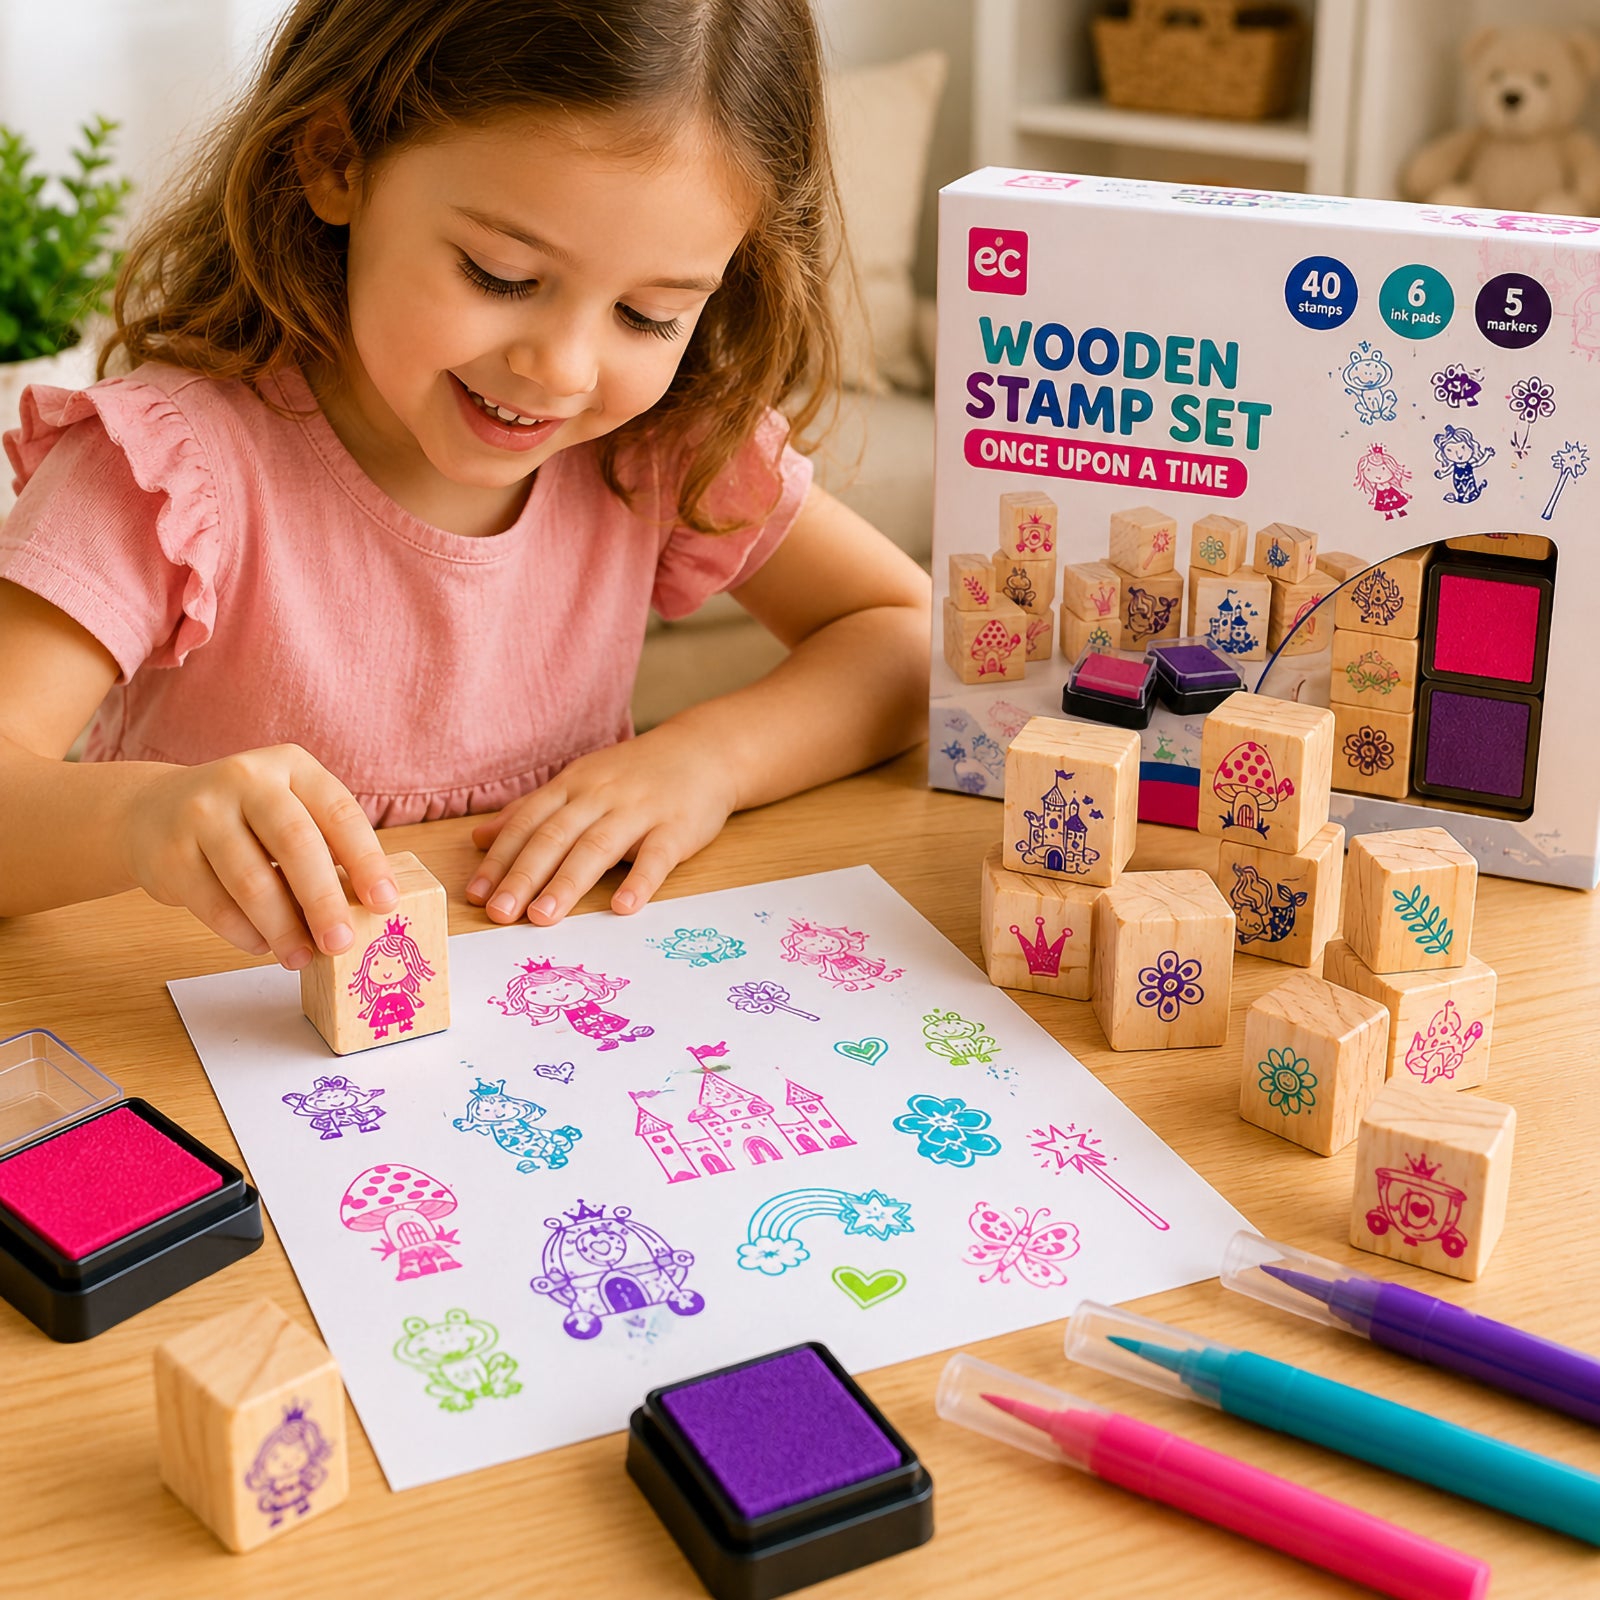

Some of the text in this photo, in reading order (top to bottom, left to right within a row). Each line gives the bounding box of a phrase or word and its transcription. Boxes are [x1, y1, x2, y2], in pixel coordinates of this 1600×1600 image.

[975, 245, 1021, 278] ec
[1302, 270, 1341, 299] 40
[1408, 279, 1426, 307] 6
[1298, 301, 1343, 317] stamps
[1504, 287, 1523, 316] 5
[1391, 308, 1441, 325] ink pads
[1487, 319, 1538, 334] markers
[979, 316, 1239, 389] WOODEN
[966, 372, 1272, 451] STAMP SET
[980, 437, 1229, 489] ONCE UPON A TIME
